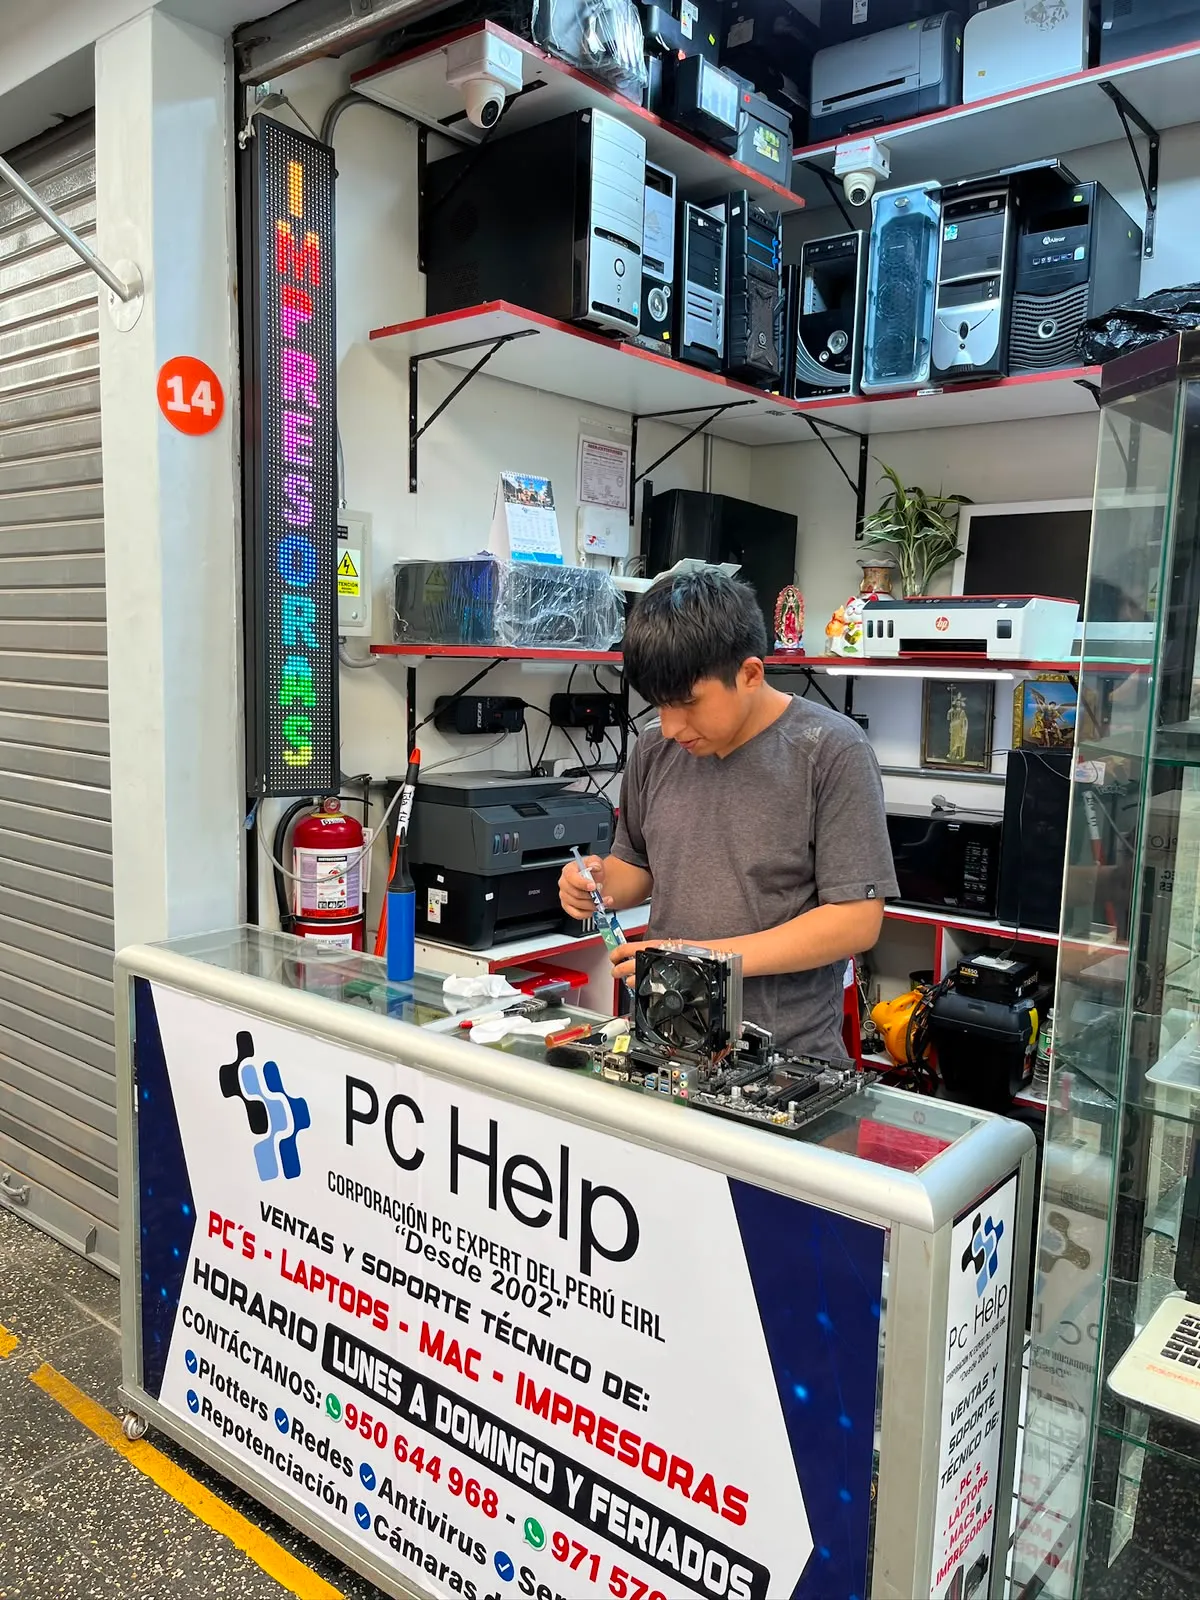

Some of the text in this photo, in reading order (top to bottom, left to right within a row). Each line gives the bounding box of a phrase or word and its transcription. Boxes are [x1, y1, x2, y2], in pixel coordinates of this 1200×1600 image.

[167, 375, 216, 416] 14
[275, 160, 320, 767] IMPRESORAS
[936, 617, 949, 631] hp
[345, 1074, 640, 1277] PC Help
[259, 1200, 651, 1413] VENTAS Y SOPORTE TÉCNICO DE:
[327, 1170, 666, 1343] CORPORACIÓN PC EXPERT DEL PERÚ EIRL
[948, 1284, 1008, 1361] PC Help
[181, 1305, 322, 1409] CONTÁCTANOS:
[343, 1403, 388, 1449] 950
[393, 1434, 442, 1484] 644
[447, 1467, 499, 1519] 968
[551, 1531, 601, 1583] 971
[193, 1257, 753, 1600] HORARIO LUNES A DOMINGO Y FERIADOS
[280, 1248, 389, 1332] LAPTOPS
[419, 1320, 482, 1382] MAC
[514, 1371, 749, 1527] IMPRESORAS
[948, 1389, 996, 1455] SOPORTE
[950, 1362, 999, 1427] VENTAS Y
[198, 1357, 270, 1422] Plotters
[290, 1417, 354, 1478] Redes
[377, 1476, 488, 1565] Antivirus
[201, 1396, 477, 1600] Repotenciación Cámaras
[940, 1430, 982, 1489] TÉCNICO
[948, 1470, 988, 1529] LAPTOPS
[935, 1504, 993, 1586] IMPRESORAS
[949, 1507, 975, 1549] MACS
